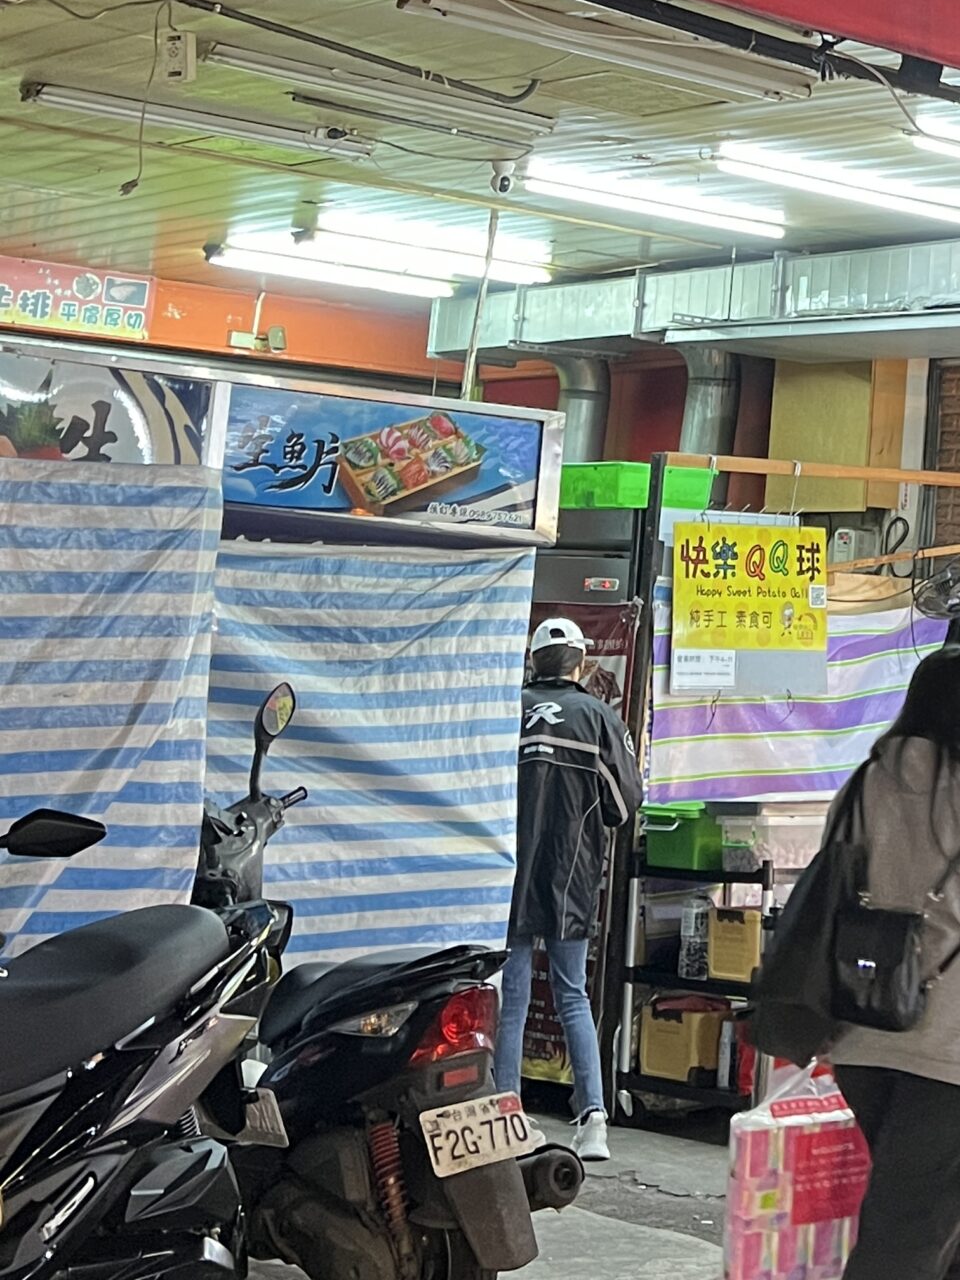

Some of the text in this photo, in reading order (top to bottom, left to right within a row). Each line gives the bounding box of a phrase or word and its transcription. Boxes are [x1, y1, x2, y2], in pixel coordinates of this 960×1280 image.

[680, 535, 822, 582] 快樂QQ球
[696, 585, 722, 599] Happy
[727, 585, 752, 598] Sweet
[756, 586, 787, 598] Potato
[689, 609, 774, 630] 純手工 素食可
